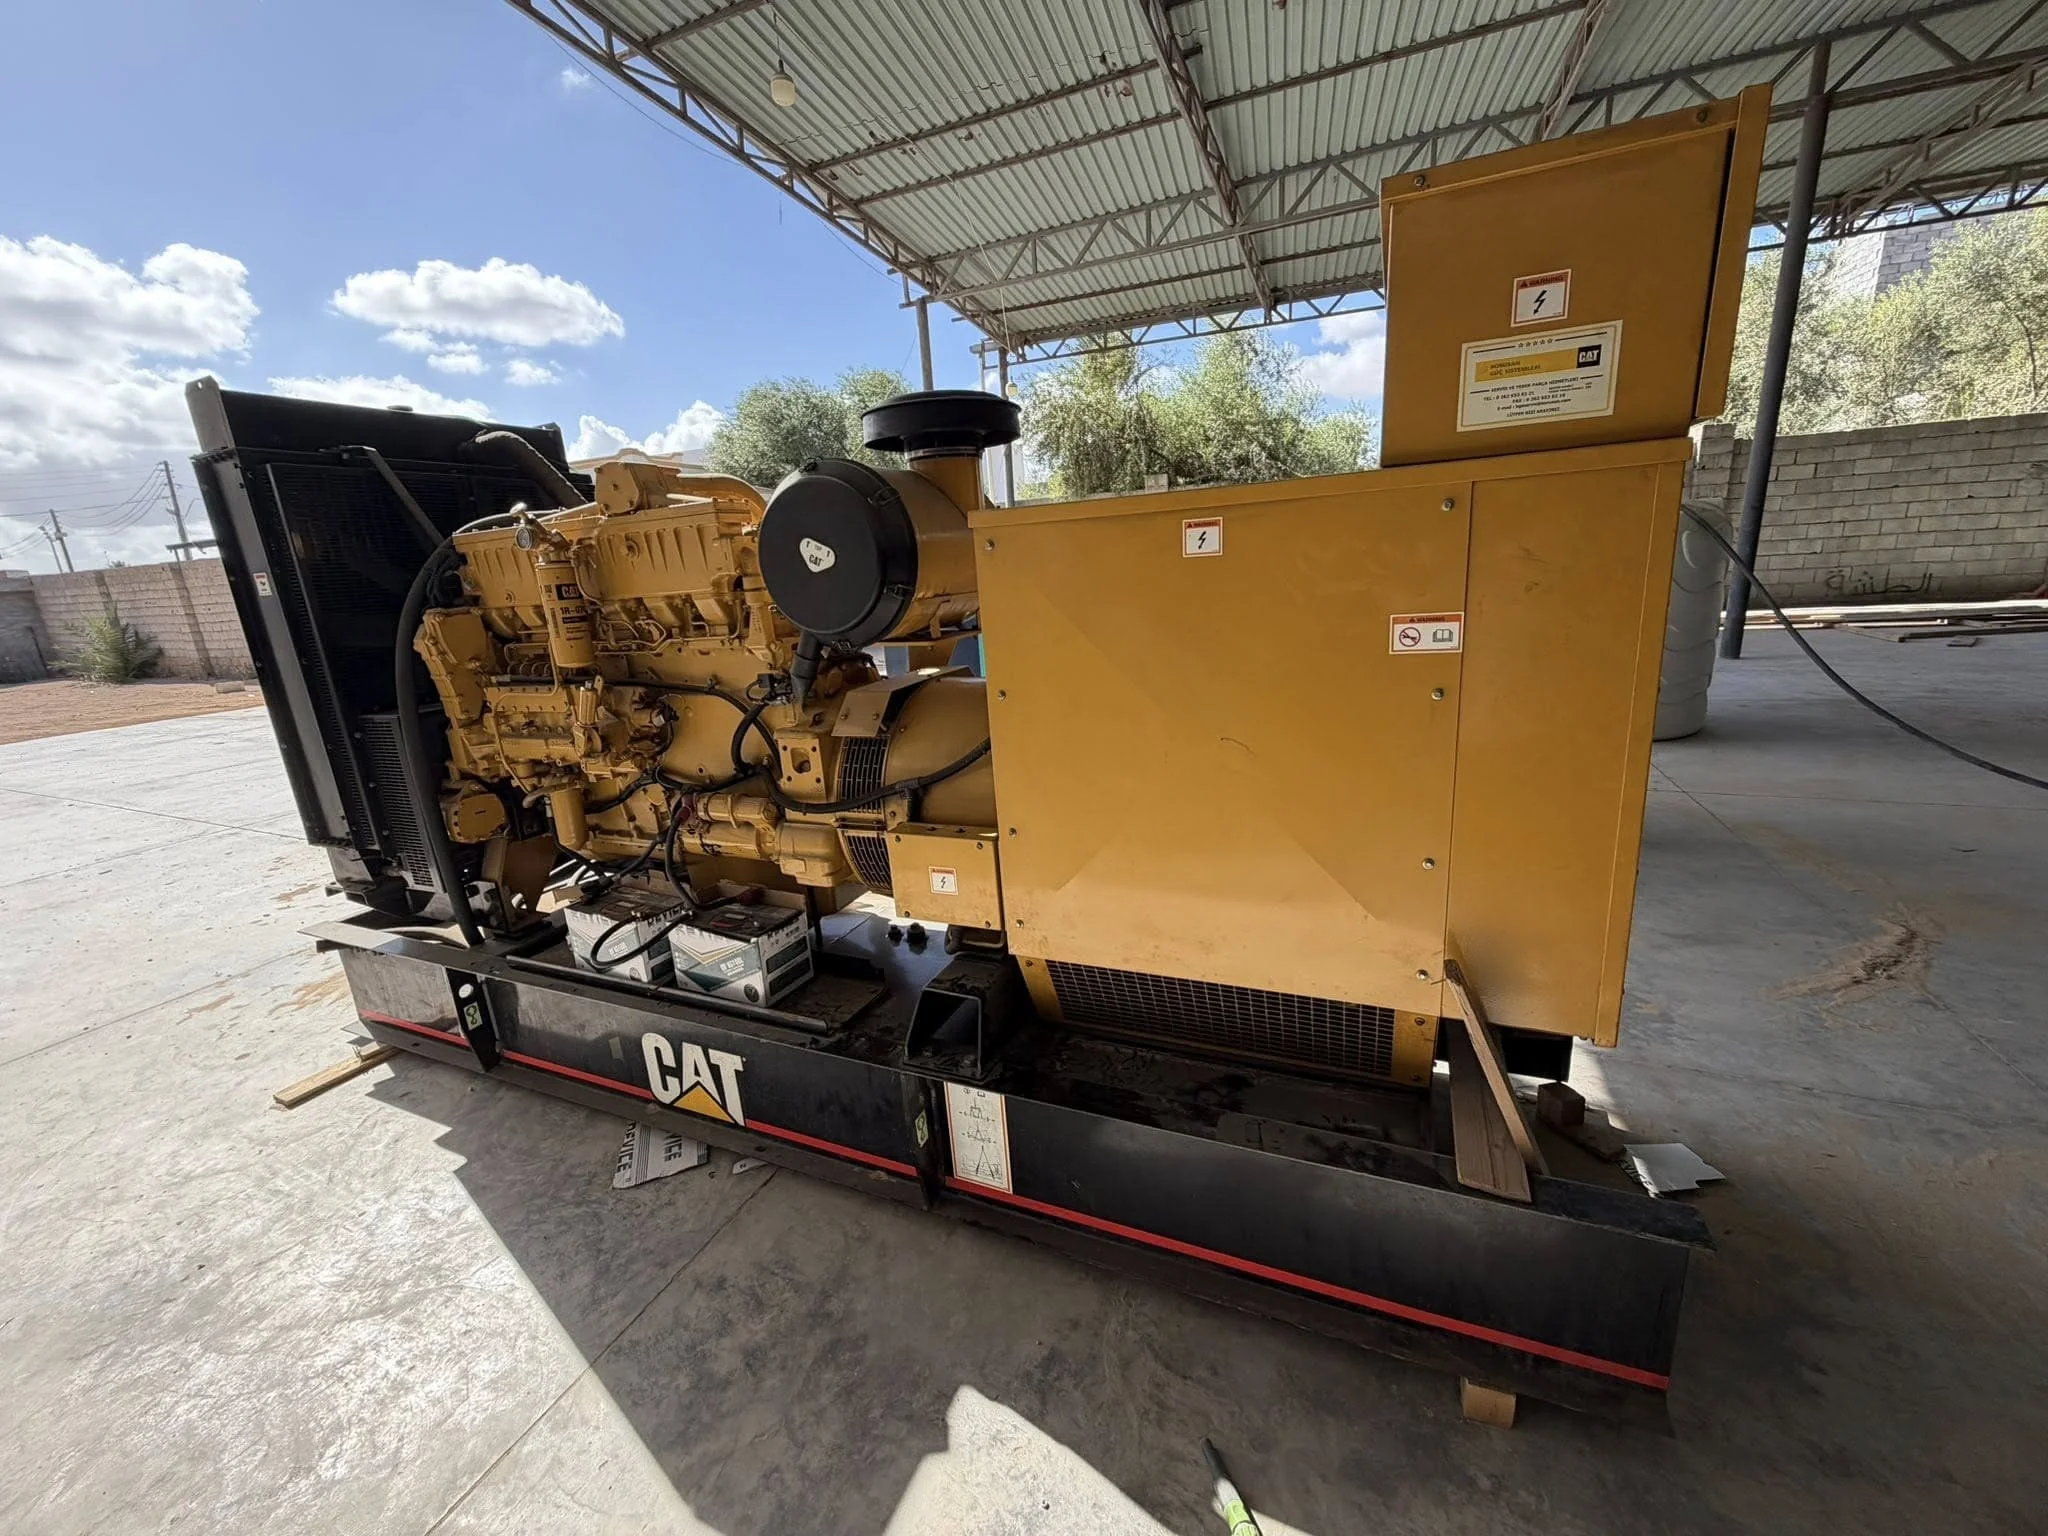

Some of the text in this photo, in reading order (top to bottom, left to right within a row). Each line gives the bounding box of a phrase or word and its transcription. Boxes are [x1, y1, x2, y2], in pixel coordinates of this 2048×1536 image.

[1579, 350, 1599, 363] CAT
[809, 554, 824, 567] CAT
[562, 585, 582, 598] CAT
[641, 1032, 746, 1127] CAT
